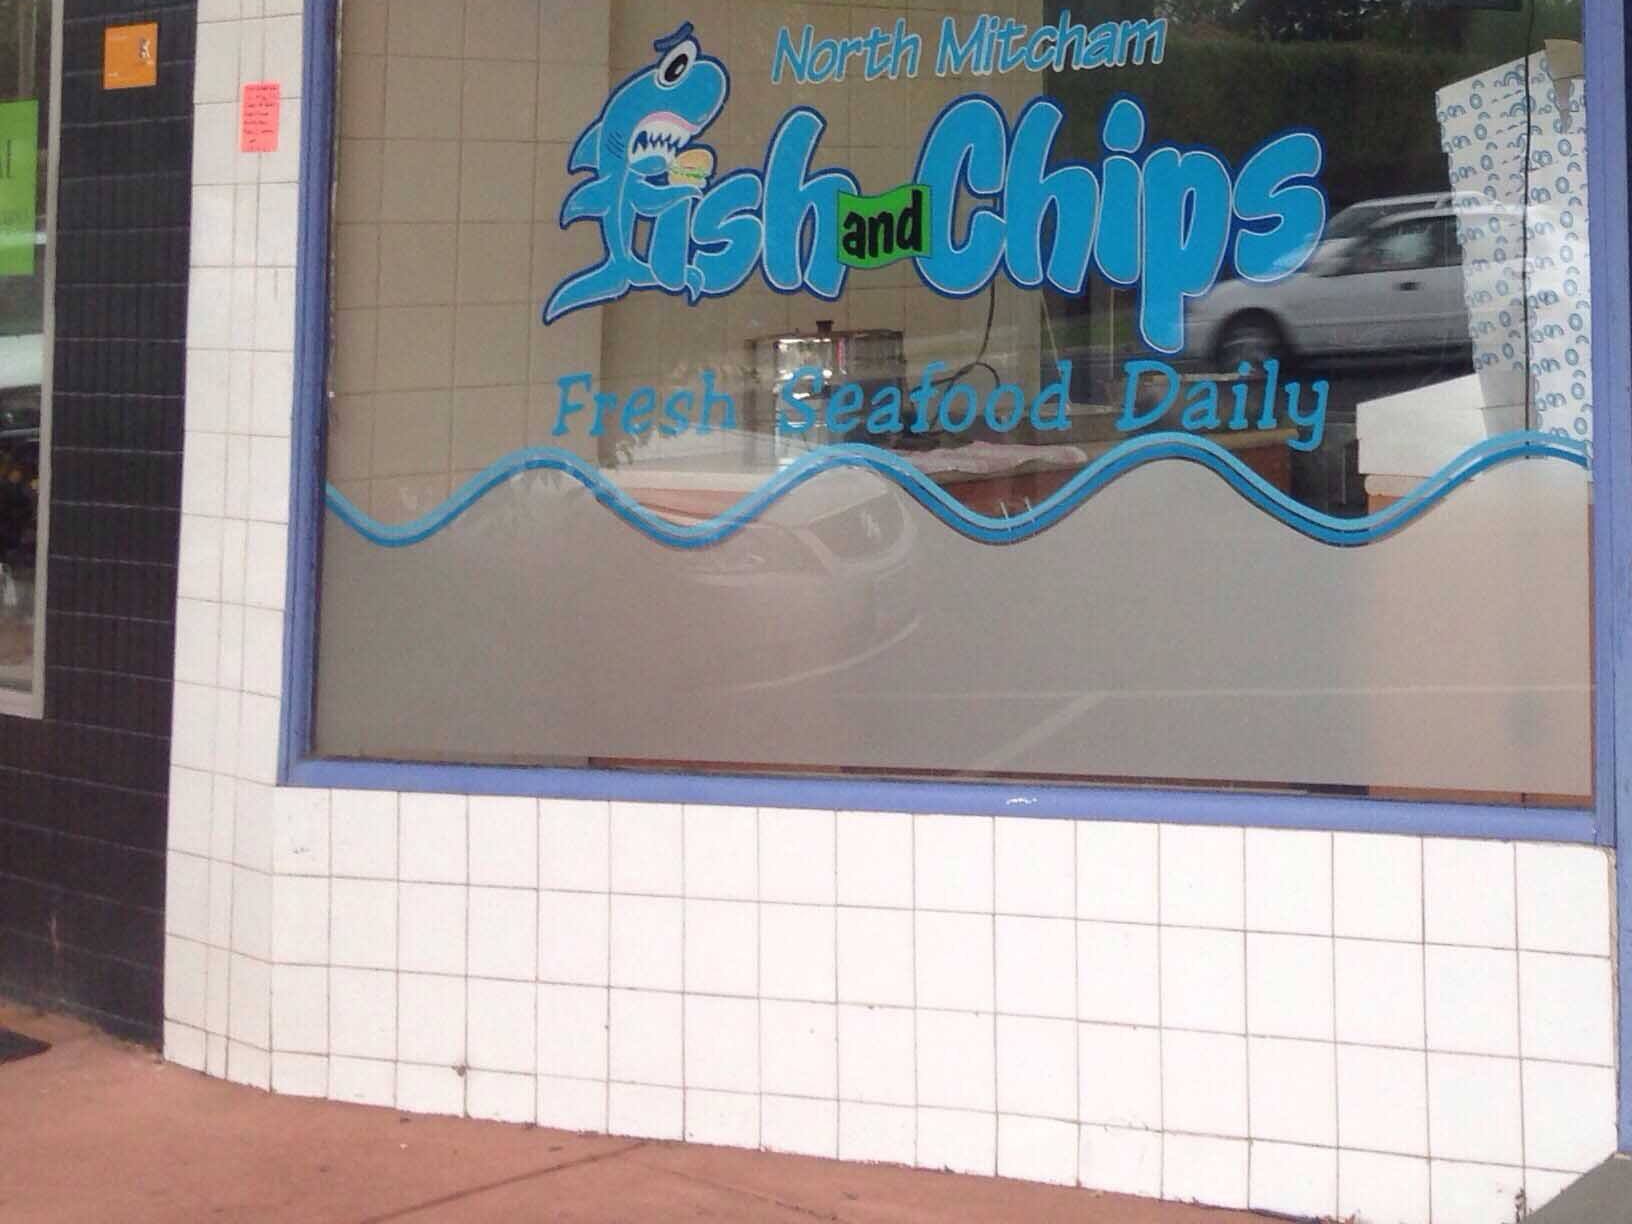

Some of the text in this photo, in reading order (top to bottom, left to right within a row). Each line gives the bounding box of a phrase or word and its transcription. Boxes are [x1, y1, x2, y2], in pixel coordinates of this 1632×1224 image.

[770, 9, 1168, 84] North Mitcham
[840, 188, 925, 260] and
[912, 92, 1328, 353] Chips
[552, 359, 1331, 452] Fresh Seafood Daily
